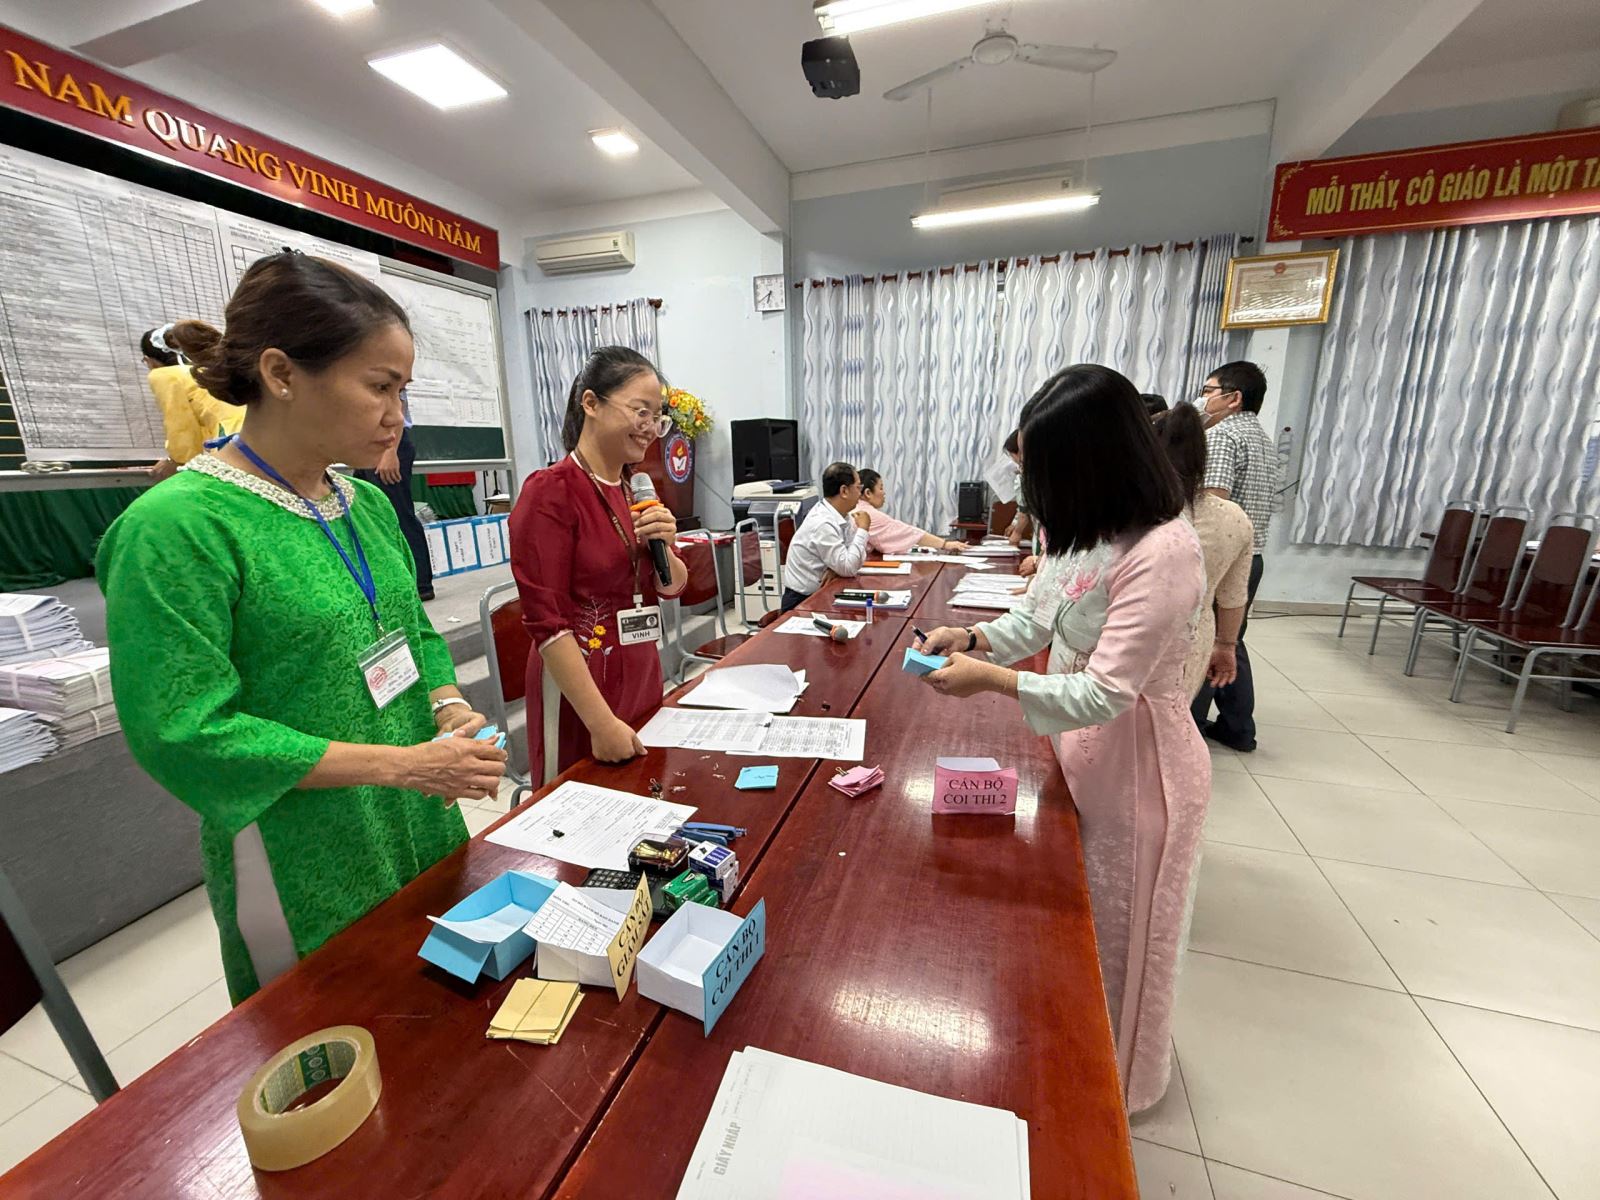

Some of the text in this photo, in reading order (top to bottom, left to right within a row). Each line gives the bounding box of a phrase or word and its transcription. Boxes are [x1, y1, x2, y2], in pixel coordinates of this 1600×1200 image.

[5, 50, 482, 254] NAM QUANG VINH MUÔN NĂM
[1305, 175, 1345, 215] MỖI
[1406, 168, 1435, 206] CÔ
[1439, 164, 1491, 203] GIÁO
[1493, 159, 1521, 197] LÀ
[1526, 154, 1580, 199] MỘT
[632, 631, 650, 639] VINH
[944, 794, 1007, 805] COI THI 2
[949, 777, 1004, 792] CÁN BỘ
[711, 970, 732, 1006] COI
[733, 941, 753, 971] THI
[713, 1121, 741, 1176] GIẤY NHÁP
